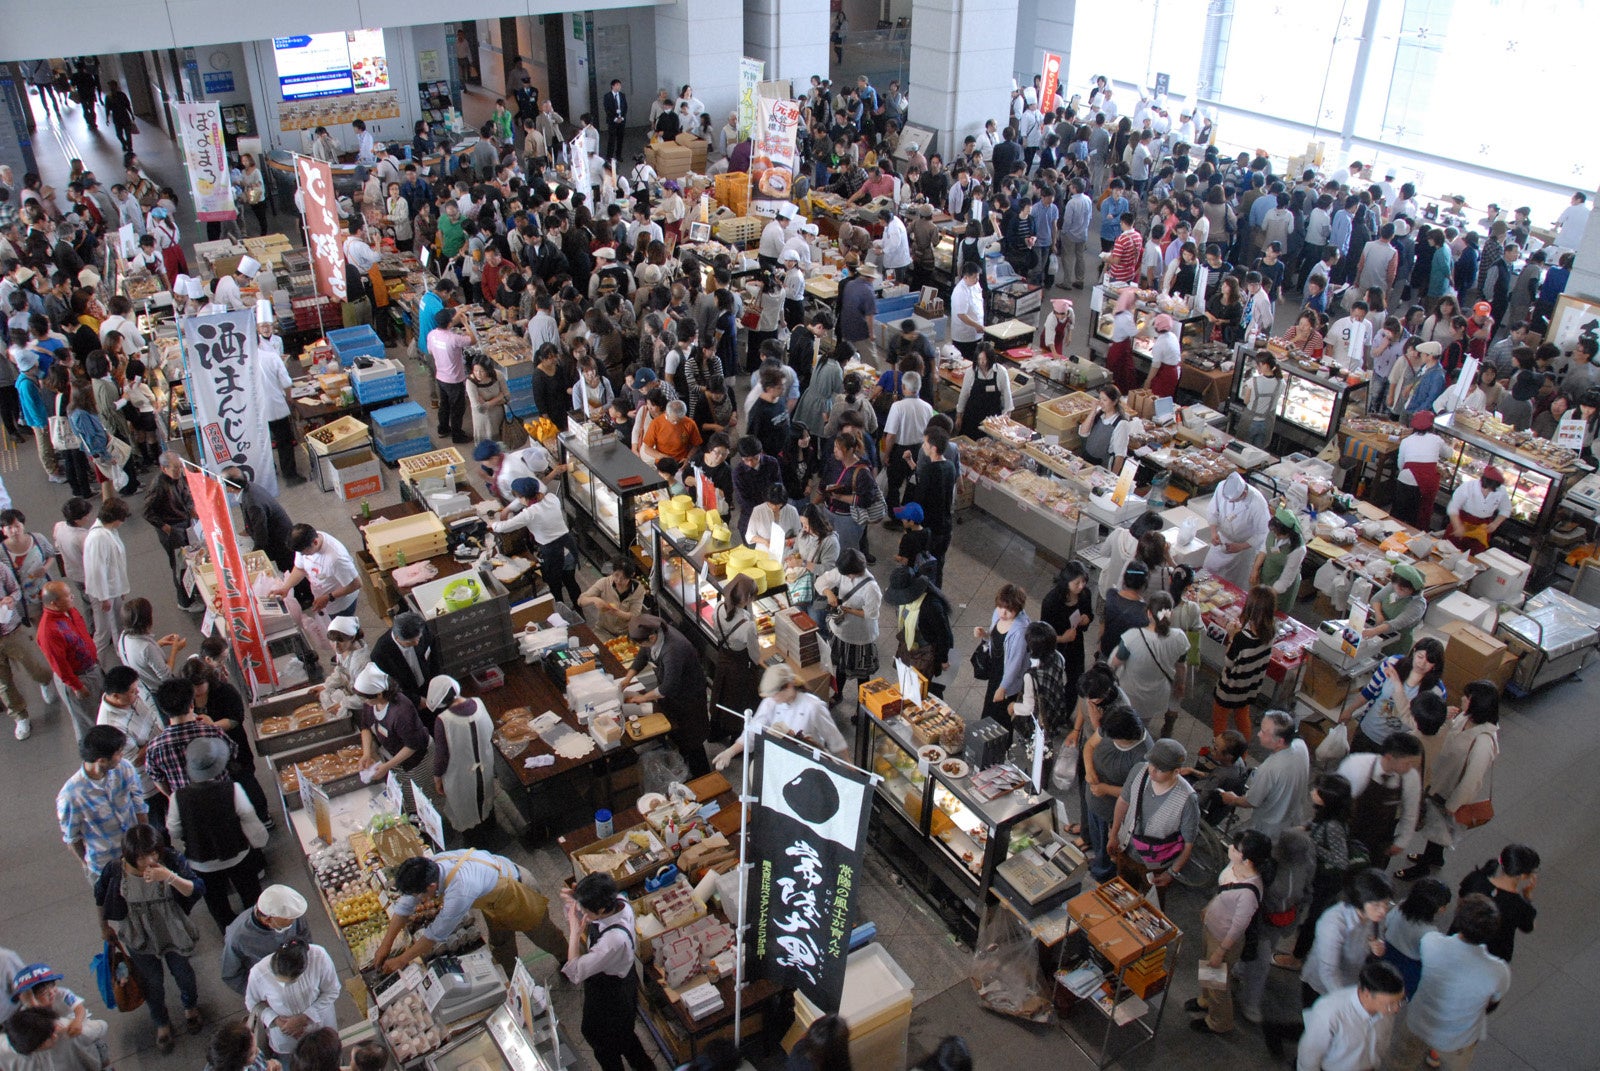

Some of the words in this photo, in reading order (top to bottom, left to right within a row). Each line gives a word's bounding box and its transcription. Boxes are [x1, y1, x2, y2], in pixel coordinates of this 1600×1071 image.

[776, 102, 799, 121] 元祖
[300, 159, 347, 298] どら焼き
[194, 322, 255, 483] 酒まんじゅう
[451, 608, 486, 624] キムラヤ
[454, 625, 490, 640] キムラヤ
[457, 641, 492, 657] キムラヤ
[286, 729, 327, 744] キムラヤ
[827, 863, 855, 959] 常陸の風土が育んだ
